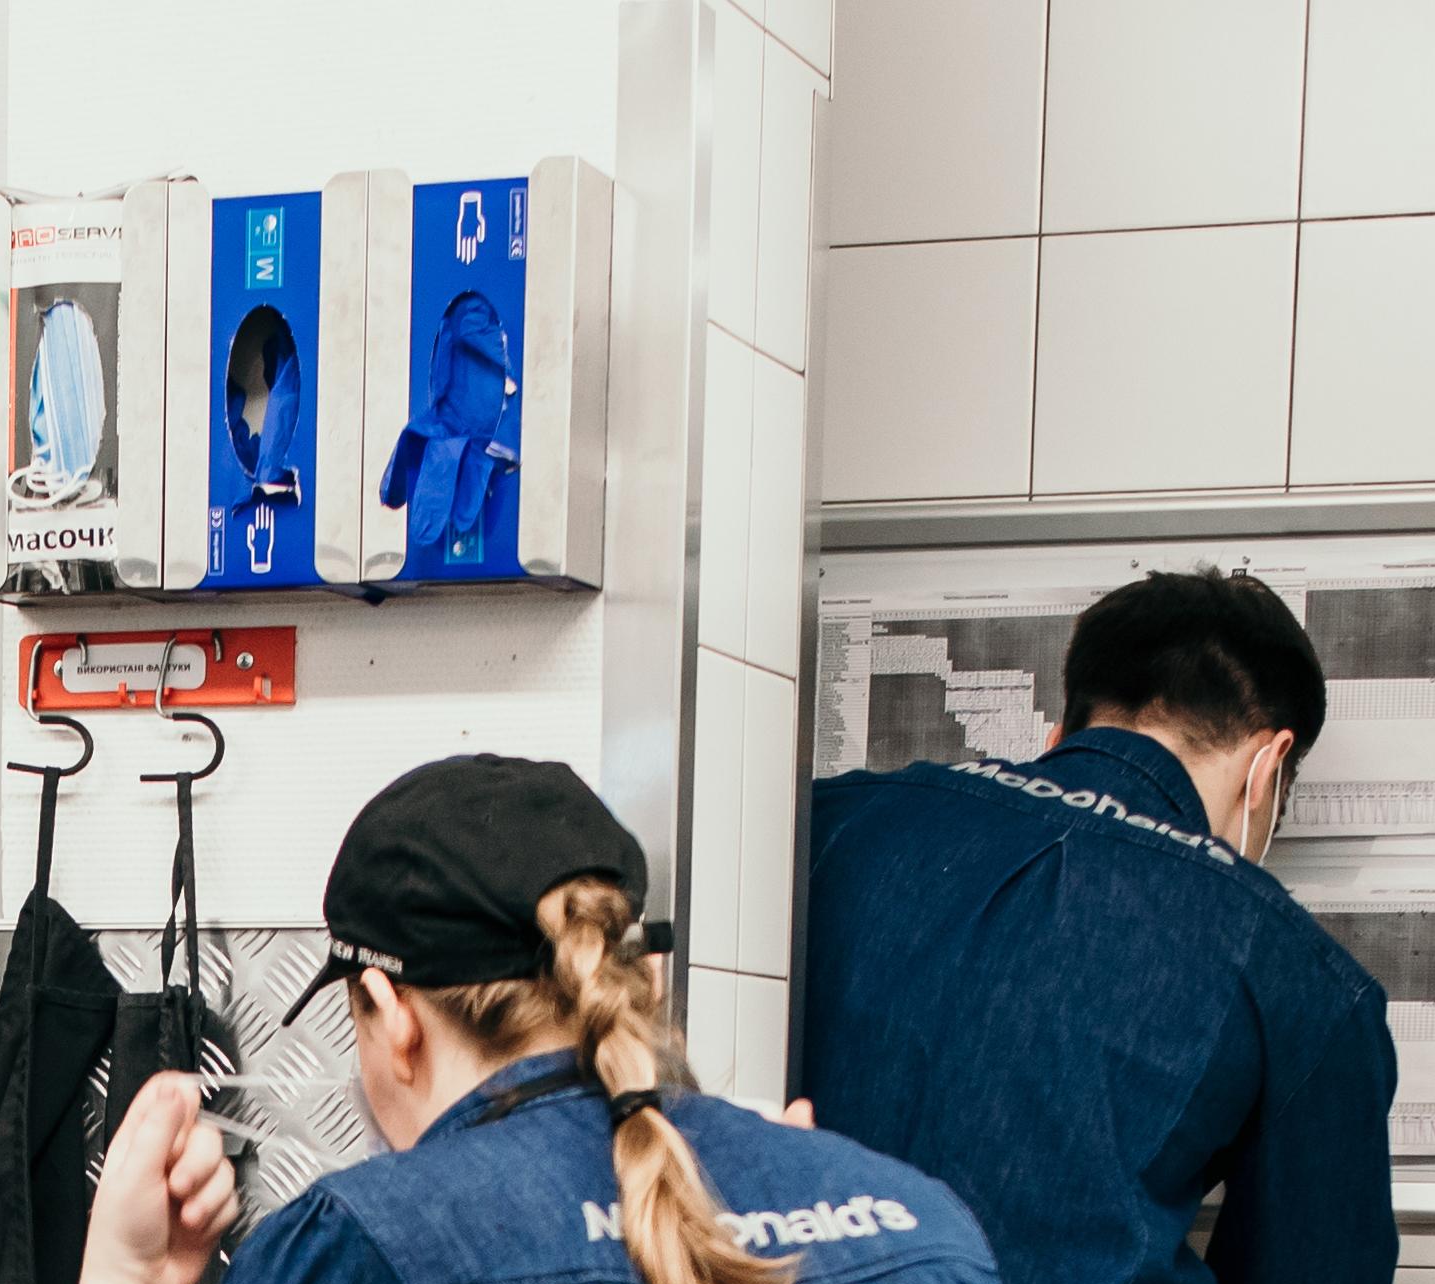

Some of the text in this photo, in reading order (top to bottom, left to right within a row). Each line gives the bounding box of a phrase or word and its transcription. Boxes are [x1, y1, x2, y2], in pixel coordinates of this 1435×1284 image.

[255, 256, 275, 281] M
[77, 662, 192, 675] ВИКОРИСТАНІ ФАТУКИ
[582, 1195, 919, 1249] Monald's
